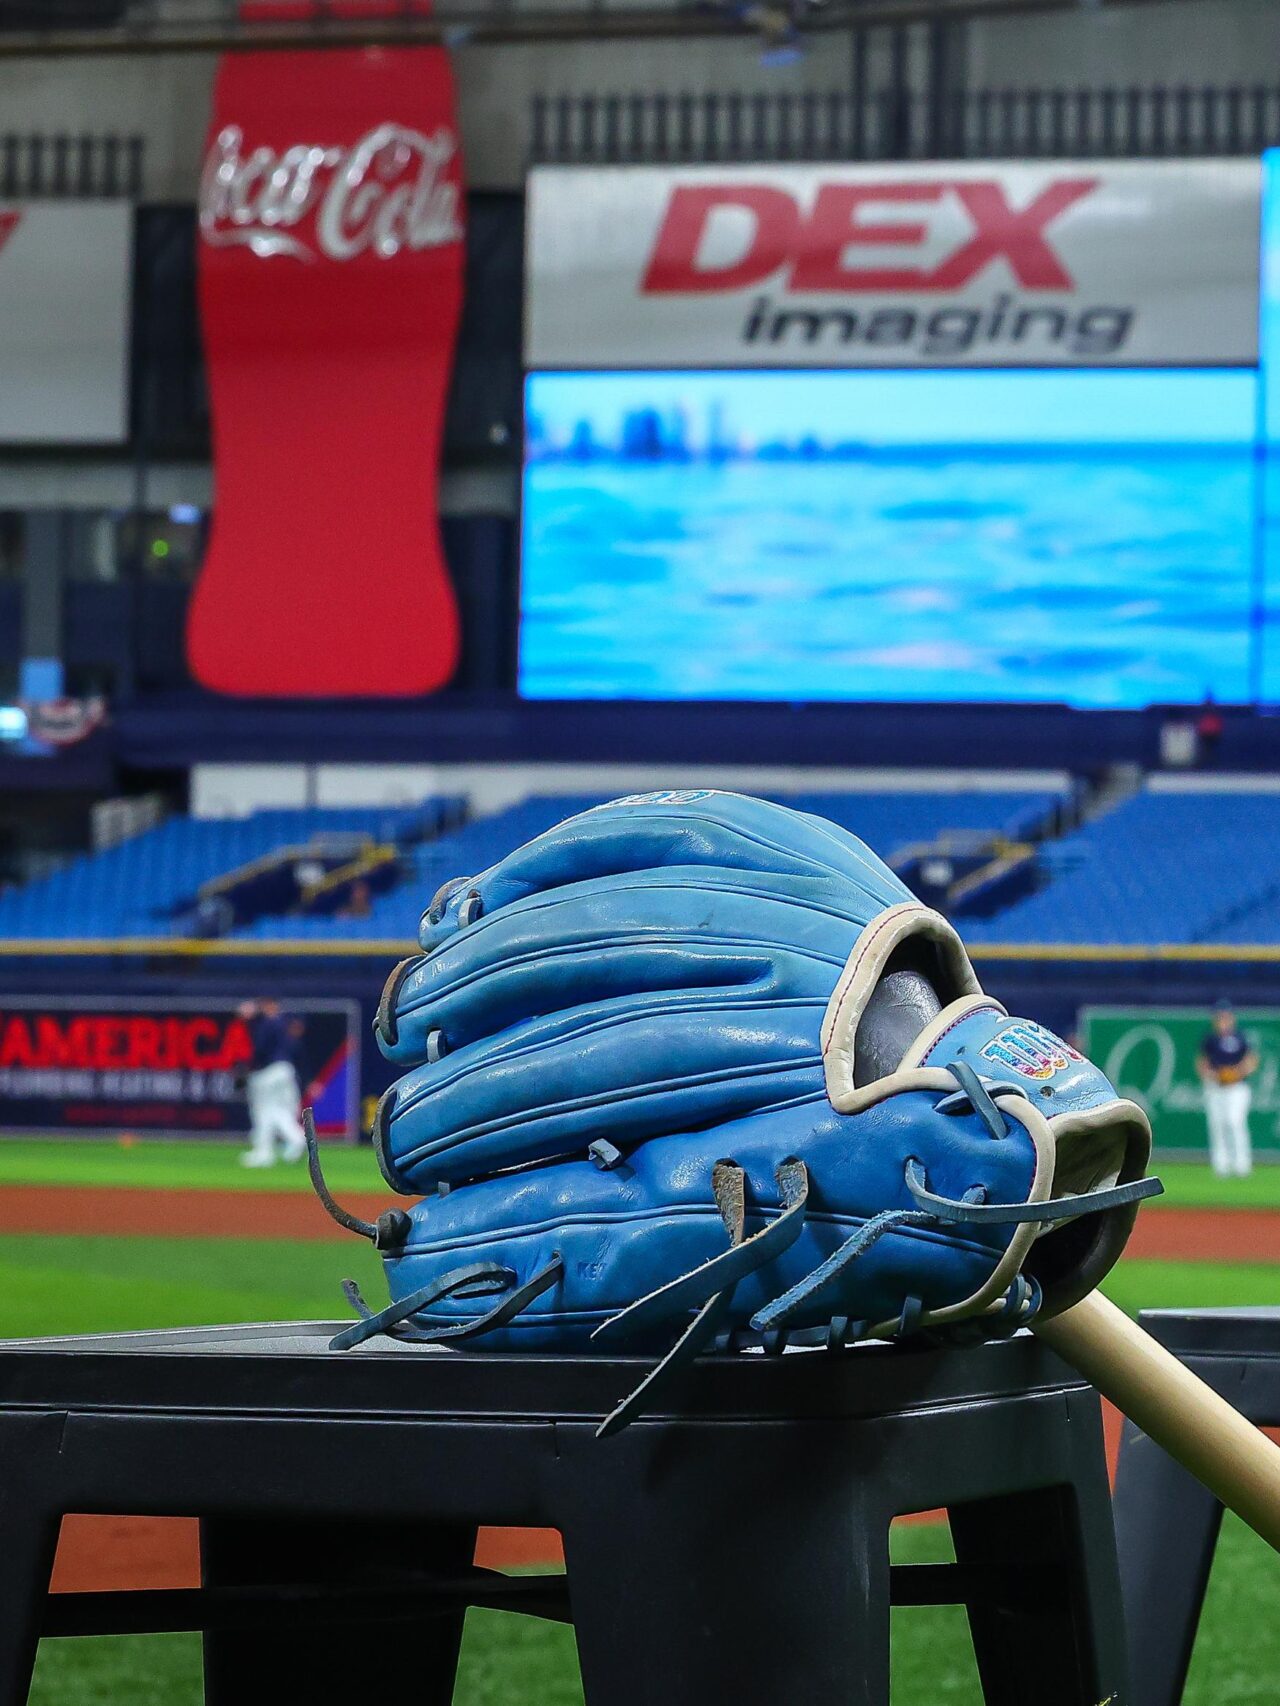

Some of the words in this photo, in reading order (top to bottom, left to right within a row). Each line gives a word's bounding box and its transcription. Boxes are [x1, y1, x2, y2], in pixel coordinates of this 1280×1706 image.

[640, 176, 1101, 295] DEX
[742, 296, 1136, 354] imaging
[1, 1015, 253, 1068] AMERICA
